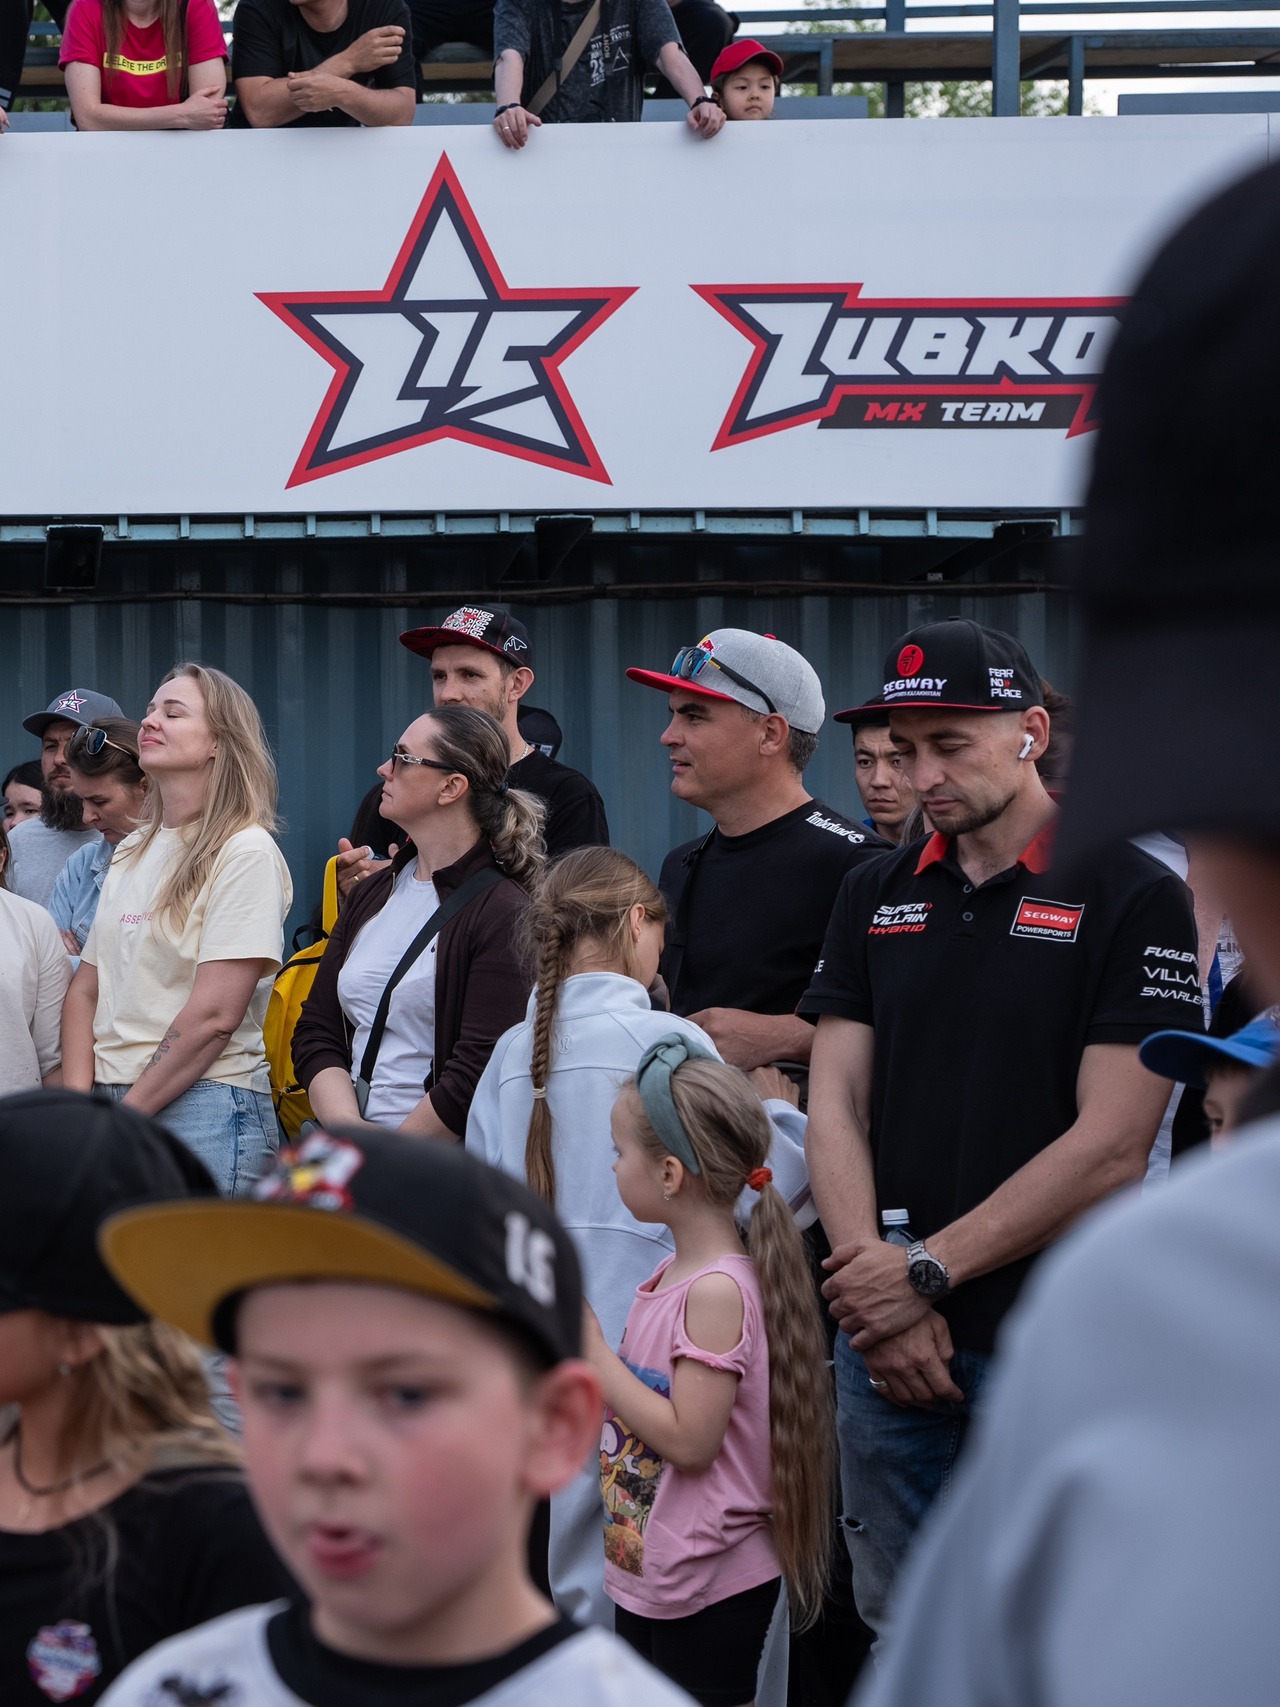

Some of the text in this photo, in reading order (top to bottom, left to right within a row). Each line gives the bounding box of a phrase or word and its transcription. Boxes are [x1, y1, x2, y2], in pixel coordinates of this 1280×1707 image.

[137, 62, 154, 72] THE
[863, 402, 1047, 422] MX TEAM
[988, 668, 1014, 678] FEAR
[883, 678, 948, 695] SEGWAY
[990, 678, 1004, 687] NO
[991, 688, 1022, 699] PLACE
[876, 903, 926, 916] SUPER
[872, 912, 928, 926] VILLAIN
[1023, 910, 1076, 924] SEGWAY
[867, 924, 927, 935] HYBRID
[1016, 925, 1073, 938] POWERSPORTS
